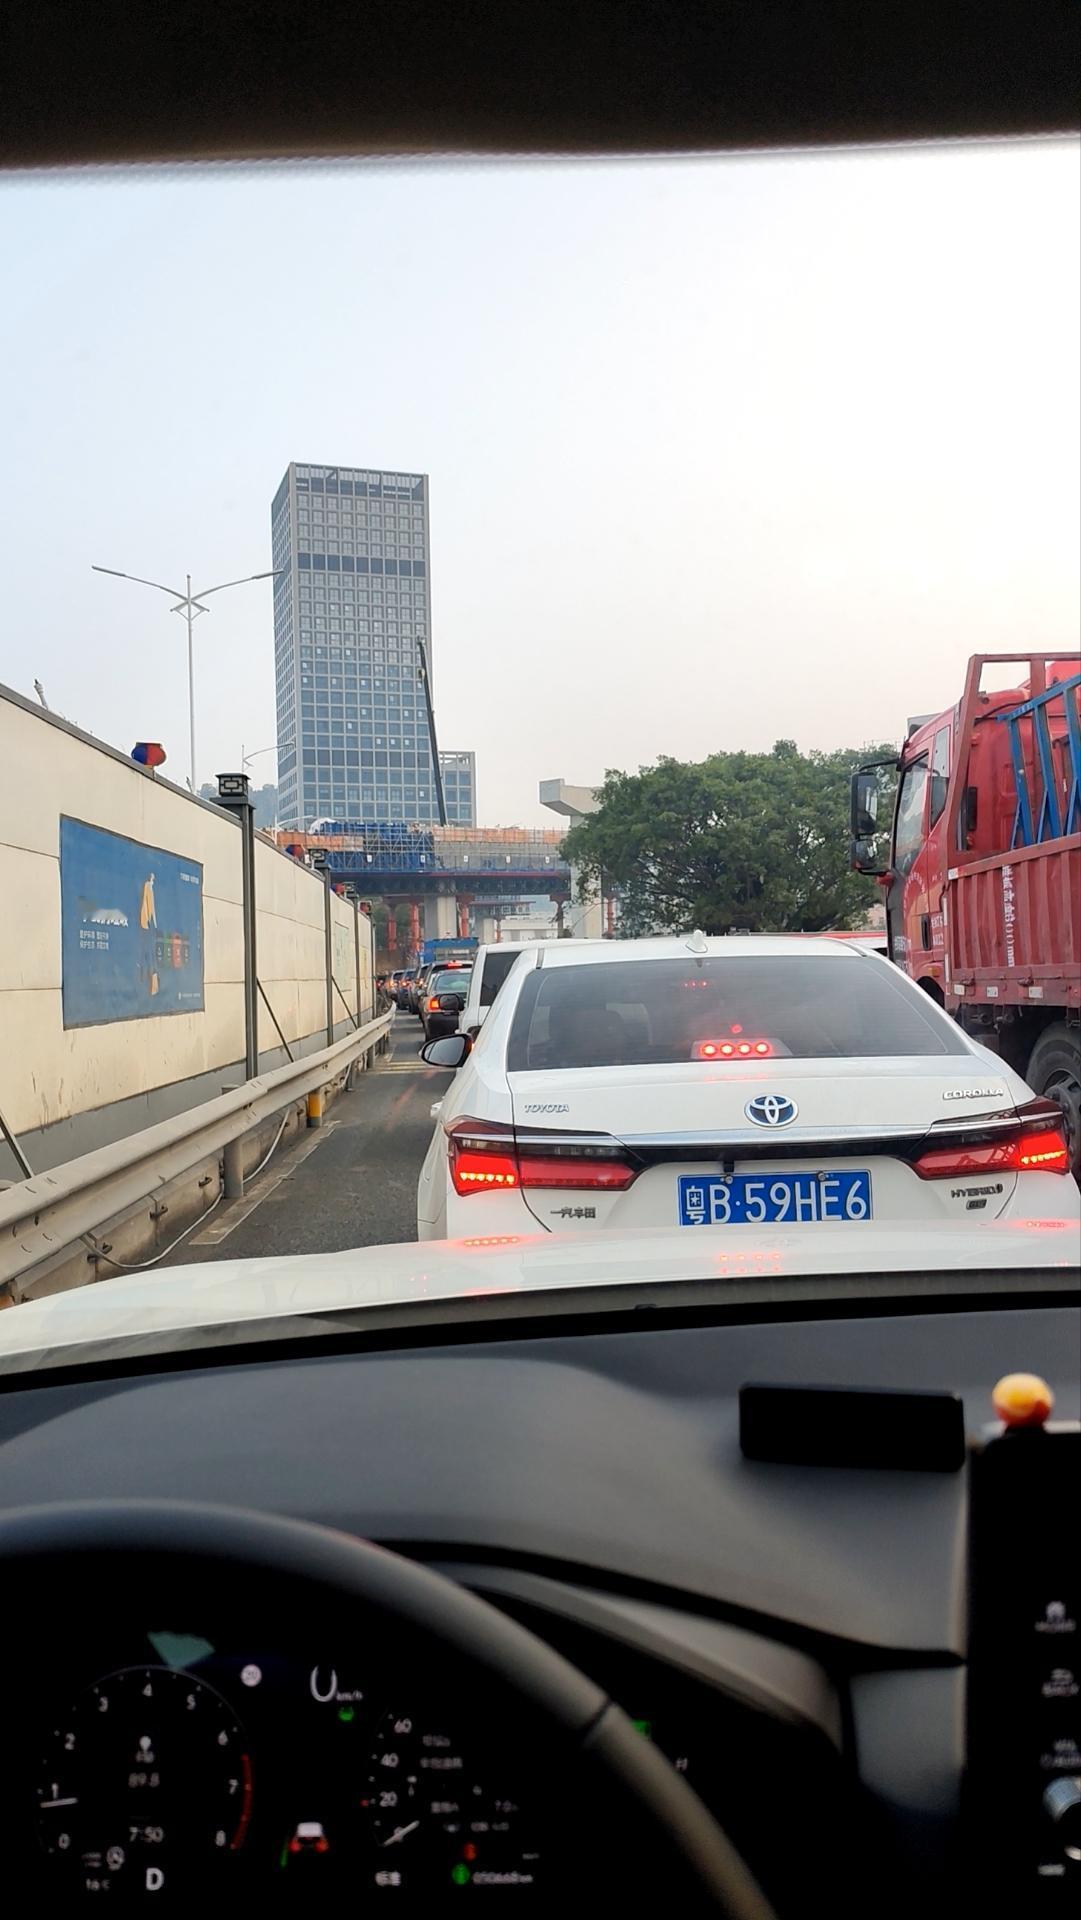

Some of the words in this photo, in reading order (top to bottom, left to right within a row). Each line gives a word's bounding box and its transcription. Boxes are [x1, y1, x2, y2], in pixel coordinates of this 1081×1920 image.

[943, 1088, 1004, 1100] COROLLA
[524, 1104, 570, 1114] TOYOTA
[685, 1179, 868, 1225] 粤B·59HE6
[143, 1683, 153, 1697] 4
[99, 1696, 109, 1712] 3
[186, 1694, 196, 1710] 5
[64, 1733, 75, 1750] 2
[218, 1731, 228, 1746] 6
[380, 1752, 400, 1769] 40
[229, 1779, 239, 1795] 7
[379, 1791, 399, 1808] 20
[58, 1833, 70, 1850] 0
[215, 1830, 226, 1847] 8
[145, 1867, 165, 1892] D
